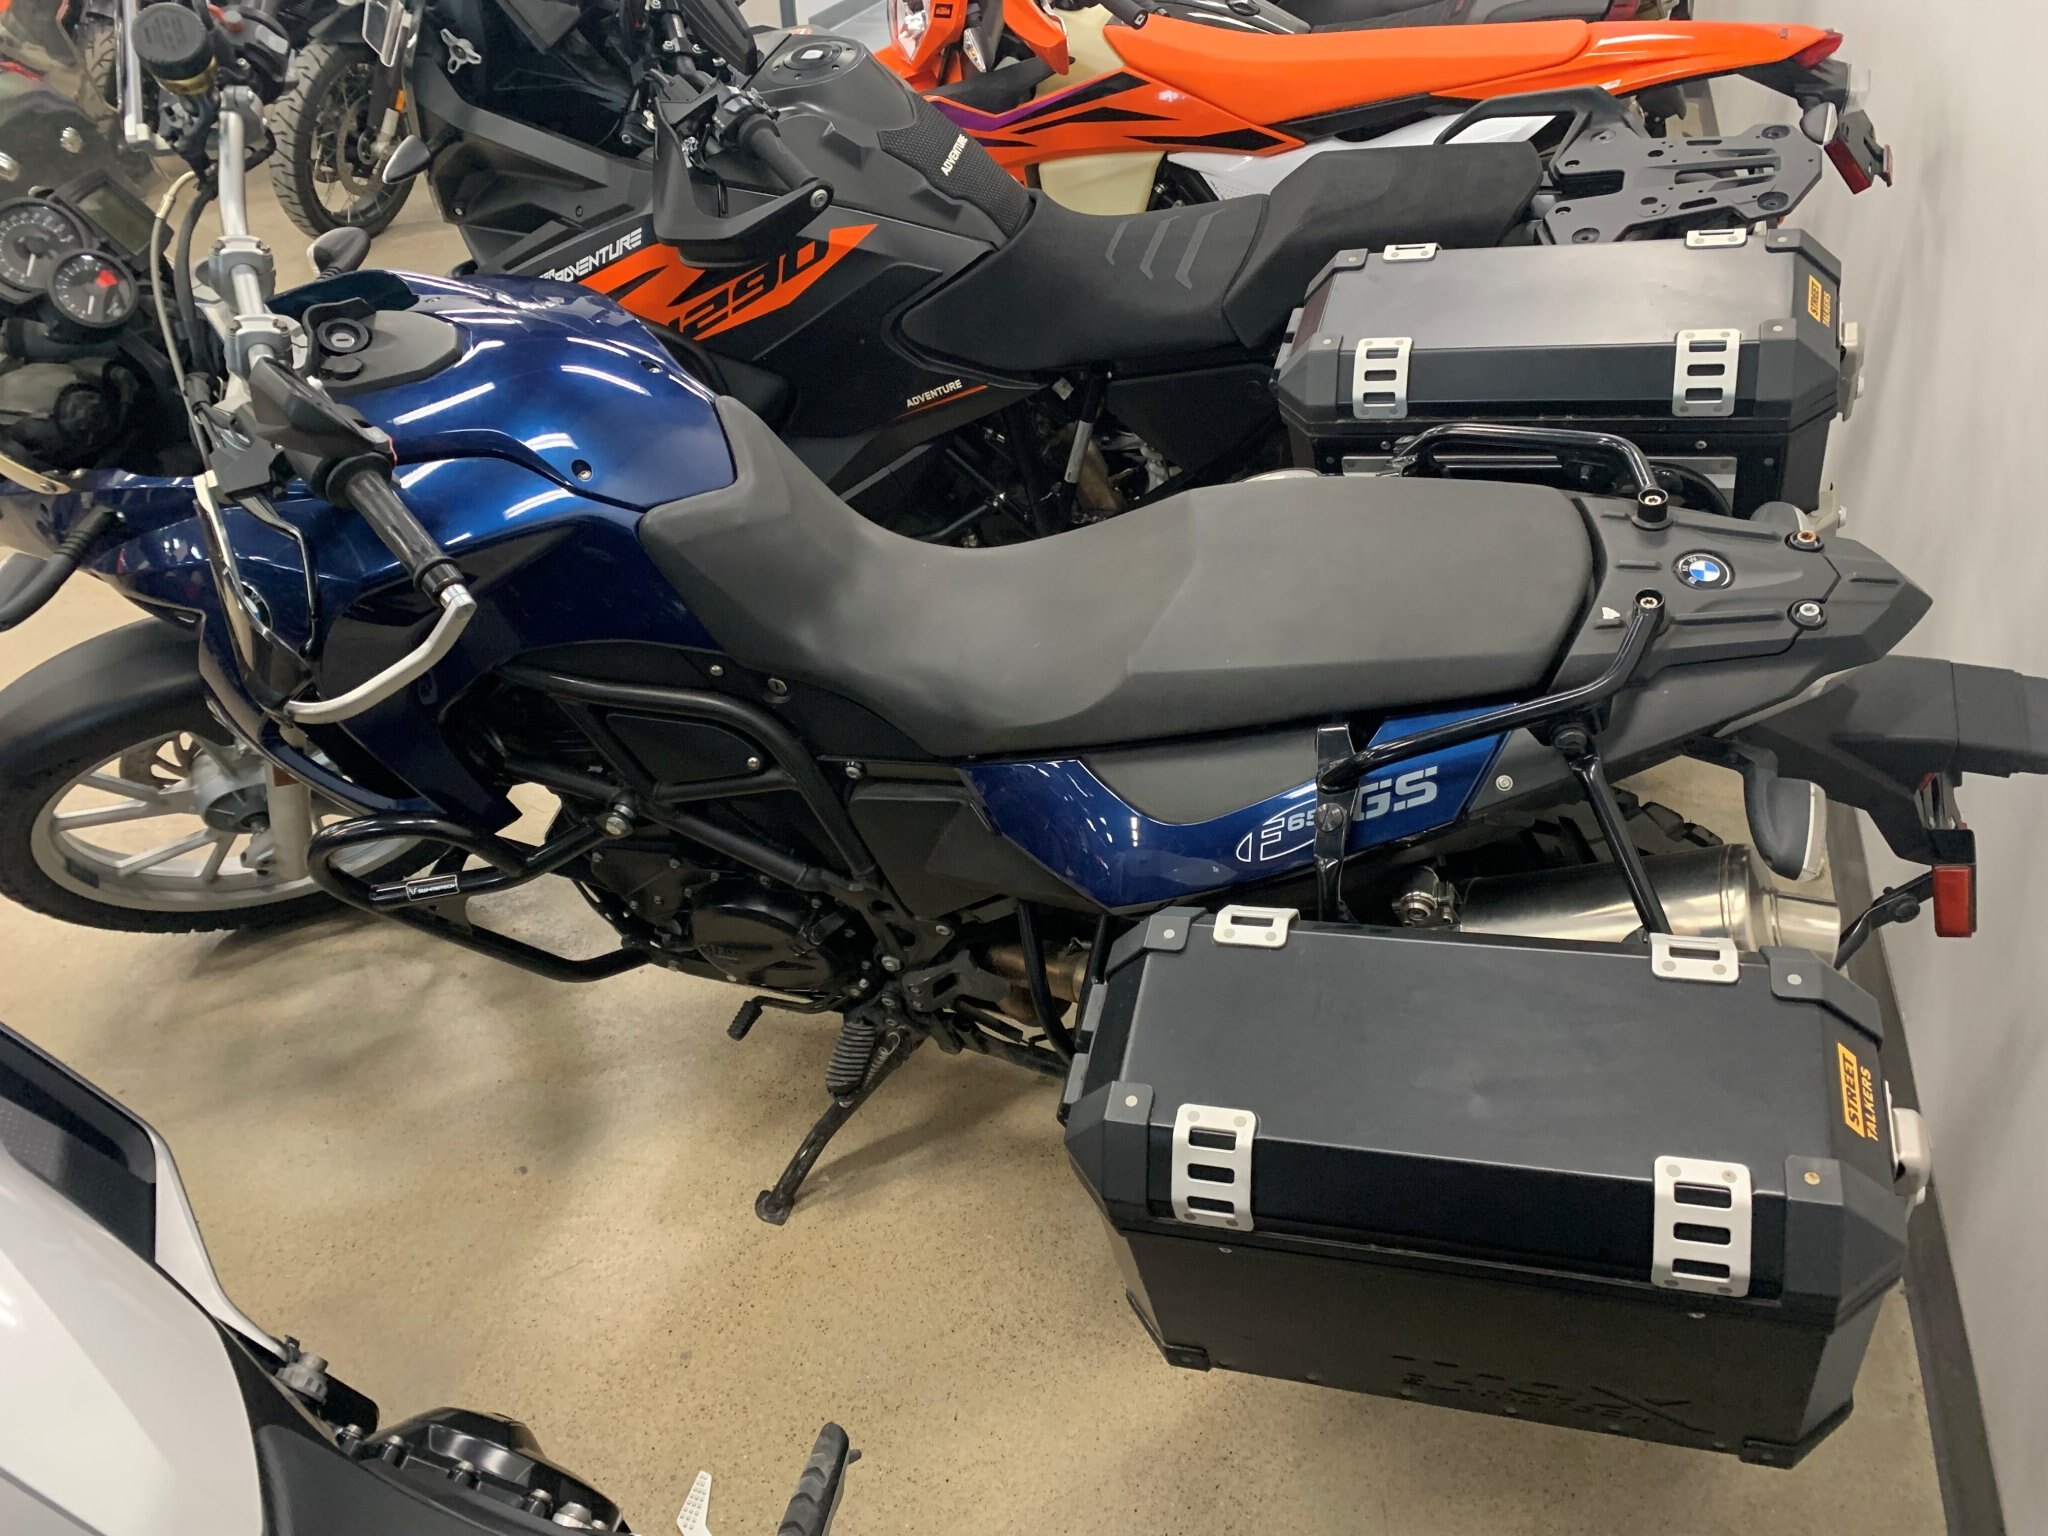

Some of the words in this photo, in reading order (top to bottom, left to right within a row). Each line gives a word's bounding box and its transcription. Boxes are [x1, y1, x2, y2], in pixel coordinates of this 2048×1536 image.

[941, 133, 968, 177] ADVENTURE
[554, 227, 642, 283] ADVENTURE
[906, 379, 963, 408] ADVENTURE
[1352, 765, 1438, 822] GS
[1842, 1052, 1860, 1127] STREET
[1860, 1065, 1878, 1142] TALKERS
